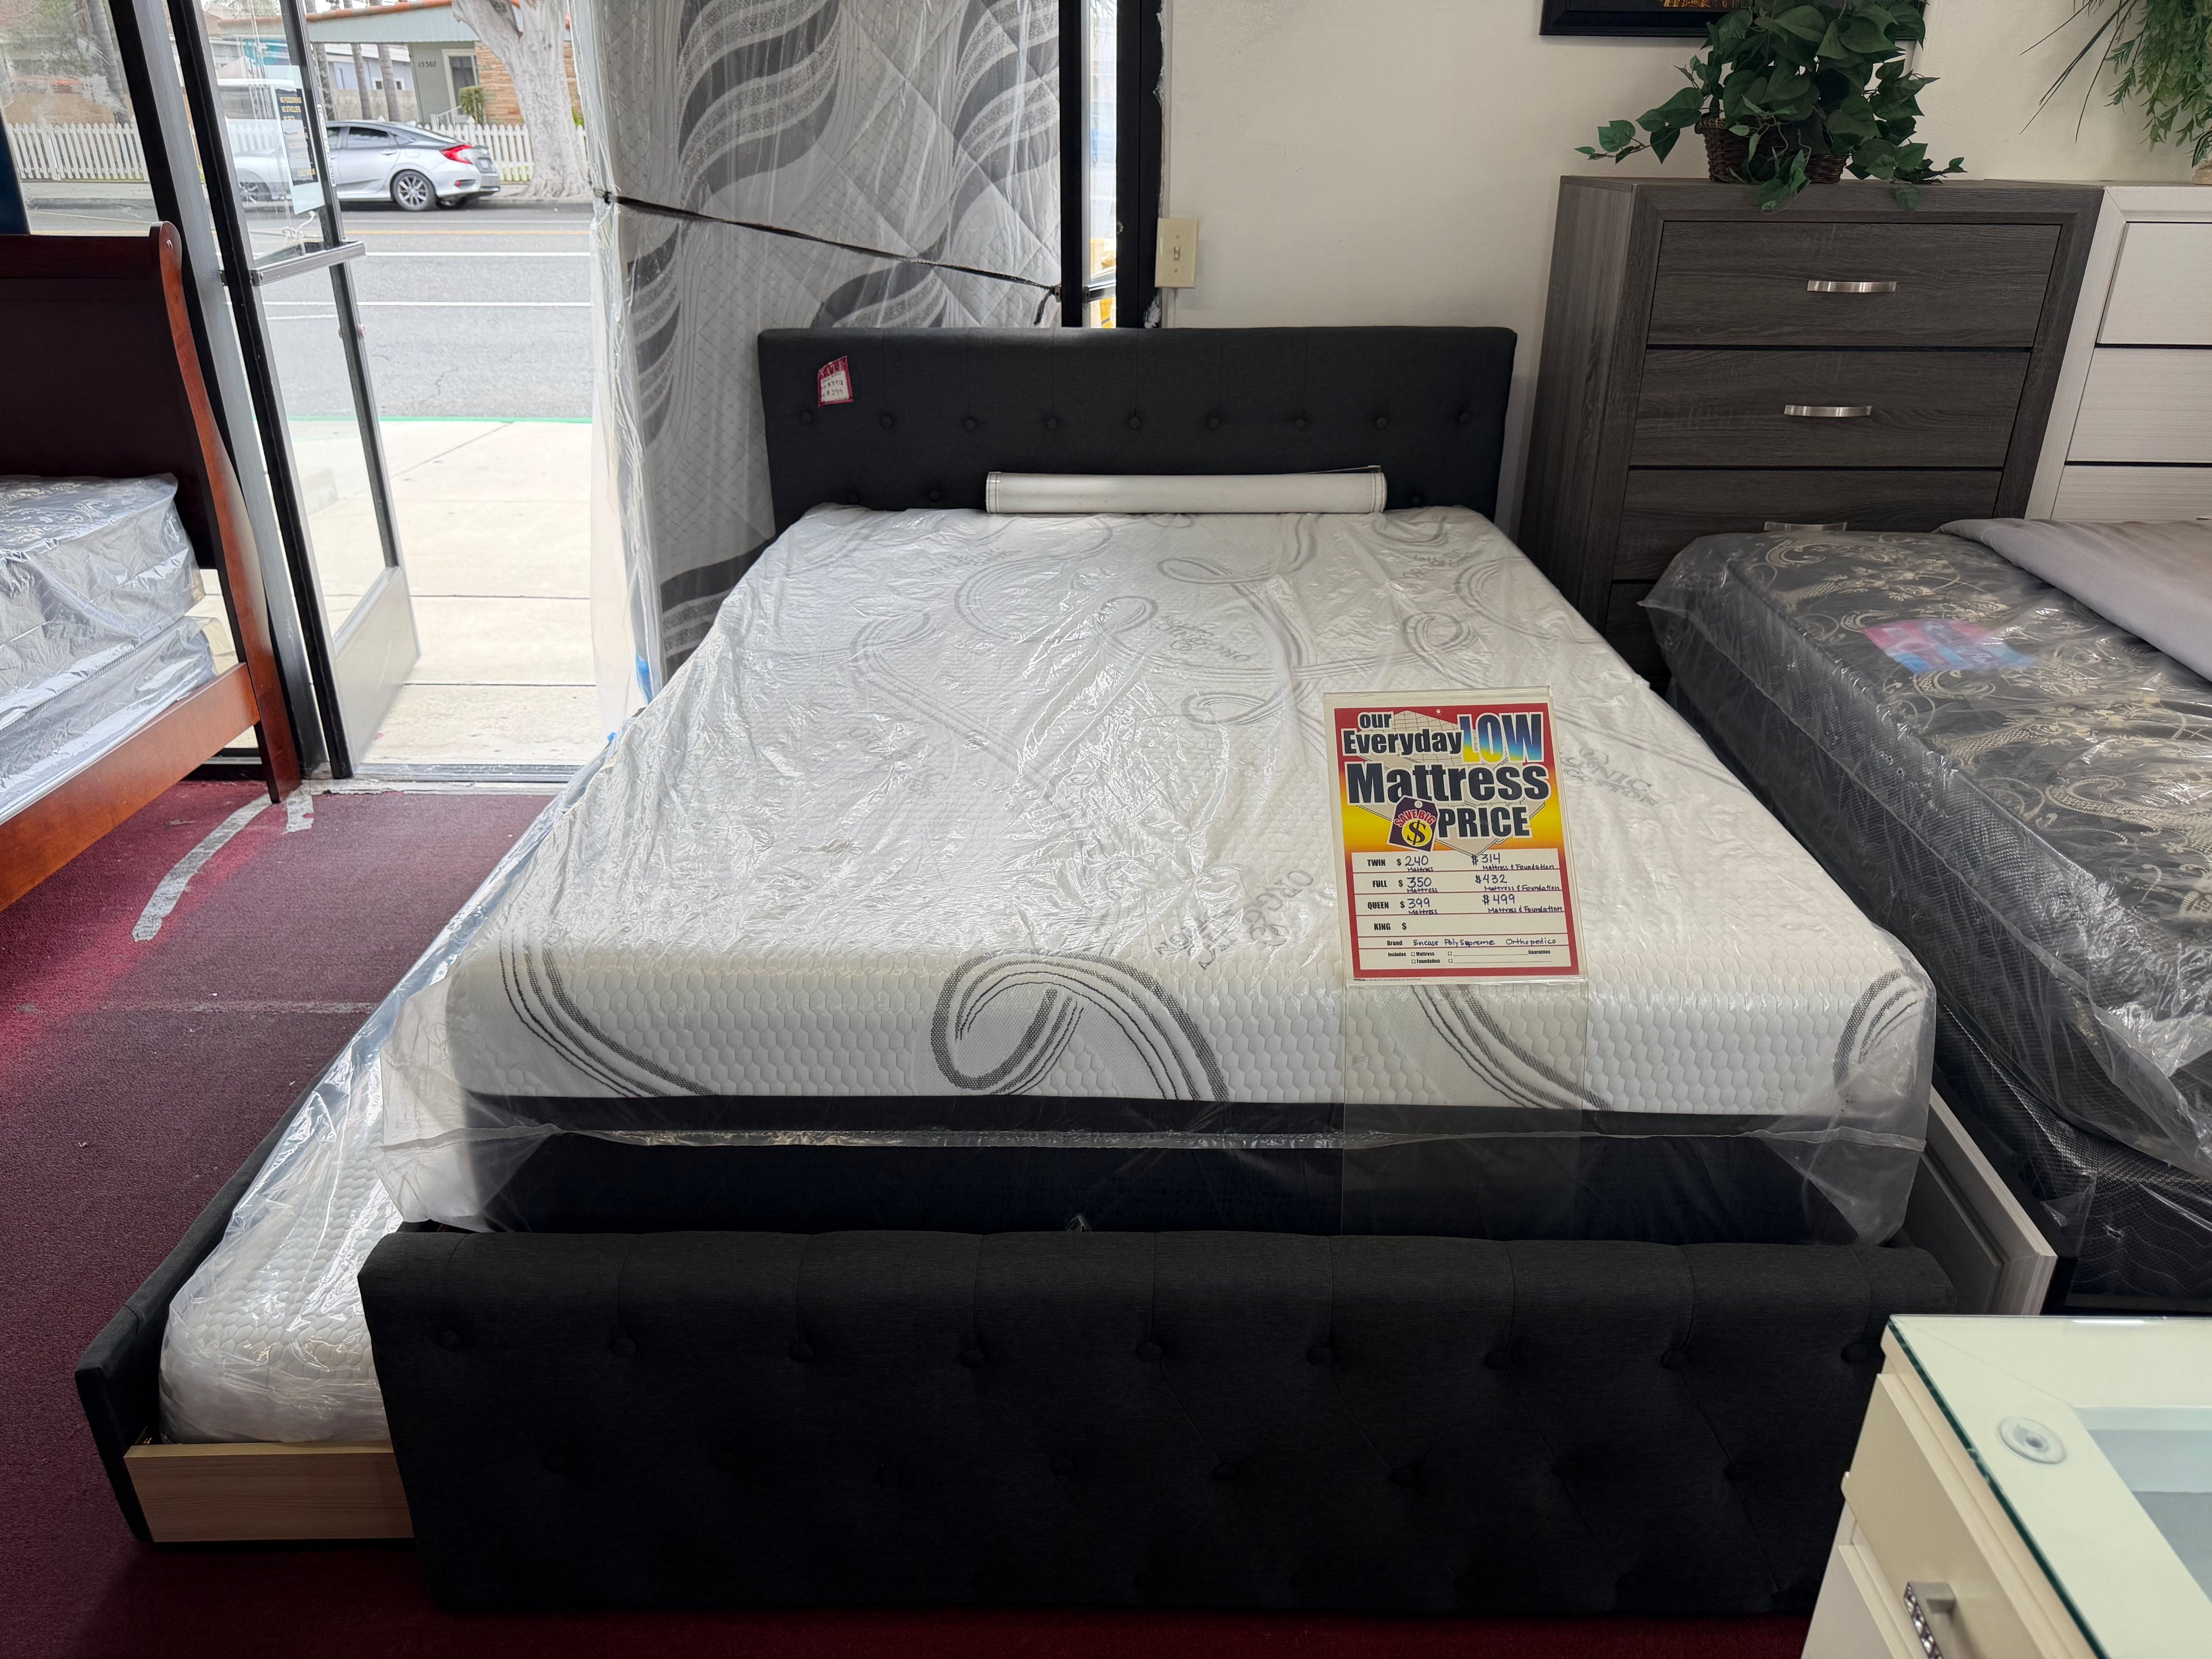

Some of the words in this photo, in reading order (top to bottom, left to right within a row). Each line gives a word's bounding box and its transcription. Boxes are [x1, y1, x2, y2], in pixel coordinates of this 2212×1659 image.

[1359, 712, 1391, 729] our
[1343, 729, 1462, 756] Everyday
[1459, 713, 1542, 762] LOW
[1347, 763, 1550, 804] Mattress
[1394, 809, 1417, 827] SAVE
[1418, 809, 1436, 825] BIG
[1438, 806, 1530, 838] PRICE
[1475, 874, 1507, 884] $432
[1368, 901, 1389, 910] QUEEN
[1374, 923, 1391, 931] KING
[1505, 937, 1556, 946] Orthopedico
